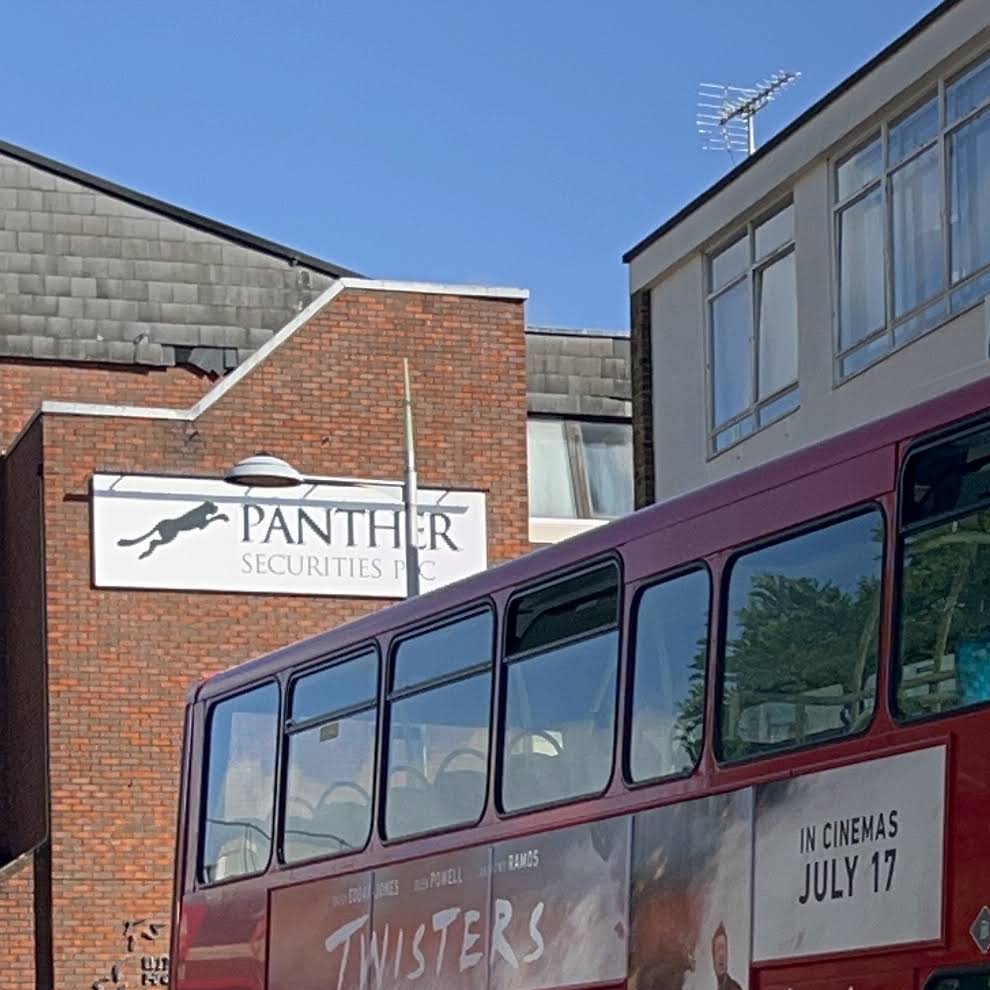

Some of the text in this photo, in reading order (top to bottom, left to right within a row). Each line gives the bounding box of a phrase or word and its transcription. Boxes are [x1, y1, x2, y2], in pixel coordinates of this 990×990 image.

[241, 553, 437, 581] SECURITIES PC
[800, 810, 898, 853] IN CINEMAS
[508, 849, 539, 872] RAMOS
[799, 848, 897, 904] JULY 17
